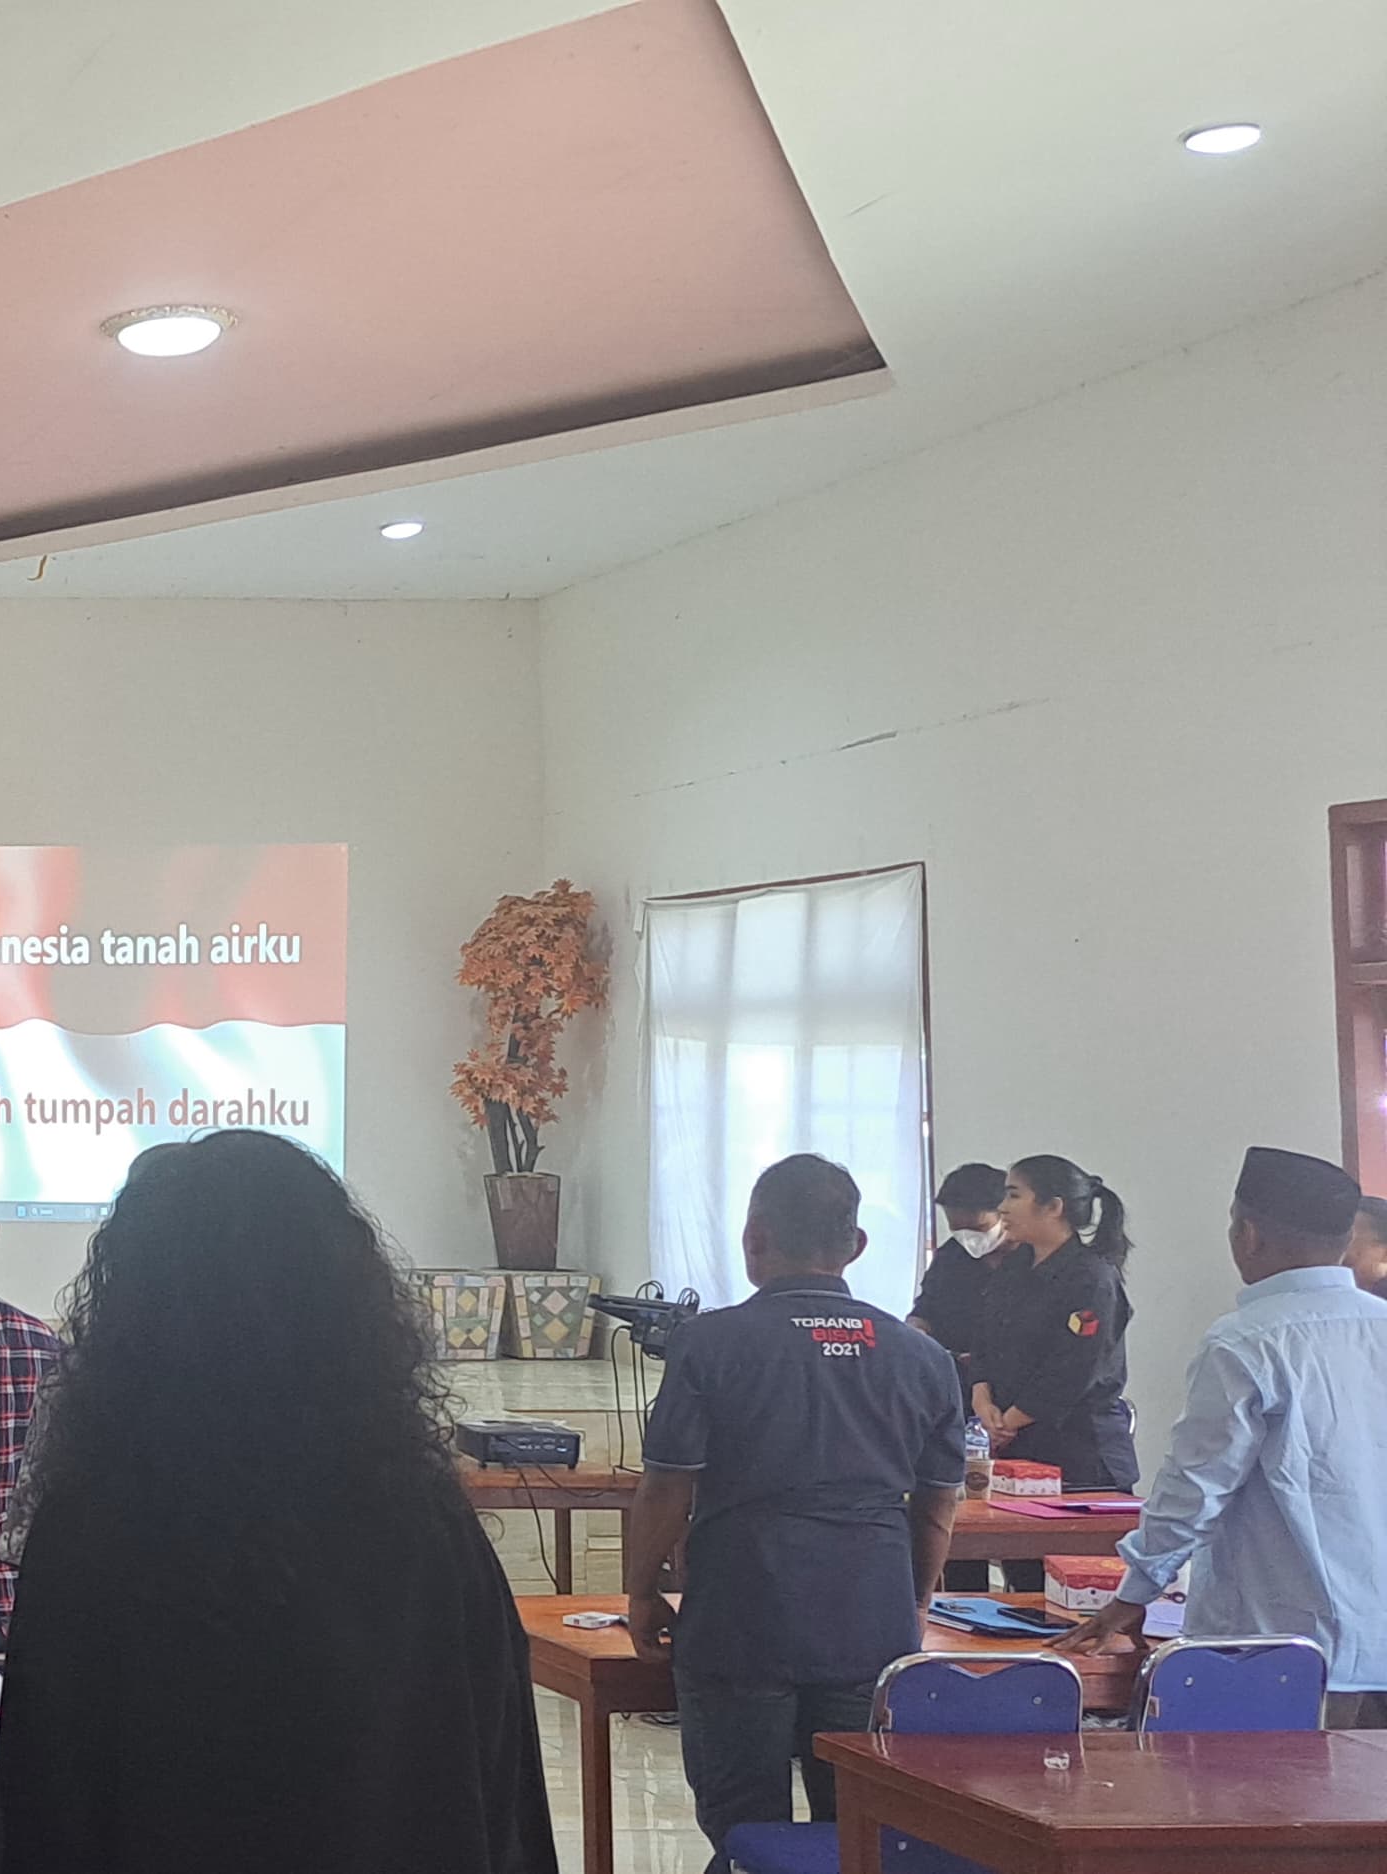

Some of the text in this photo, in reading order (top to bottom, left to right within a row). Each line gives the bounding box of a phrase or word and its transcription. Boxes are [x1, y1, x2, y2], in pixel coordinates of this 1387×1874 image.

[100, 924, 199, 965] tanah
[210, 924, 301, 964] airku
[25, 1087, 156, 1135] tumpah
[168, 1087, 310, 1127] darahku
[790, 1317, 863, 1329] TORANG
[822, 1342, 860, 1356] 2021
